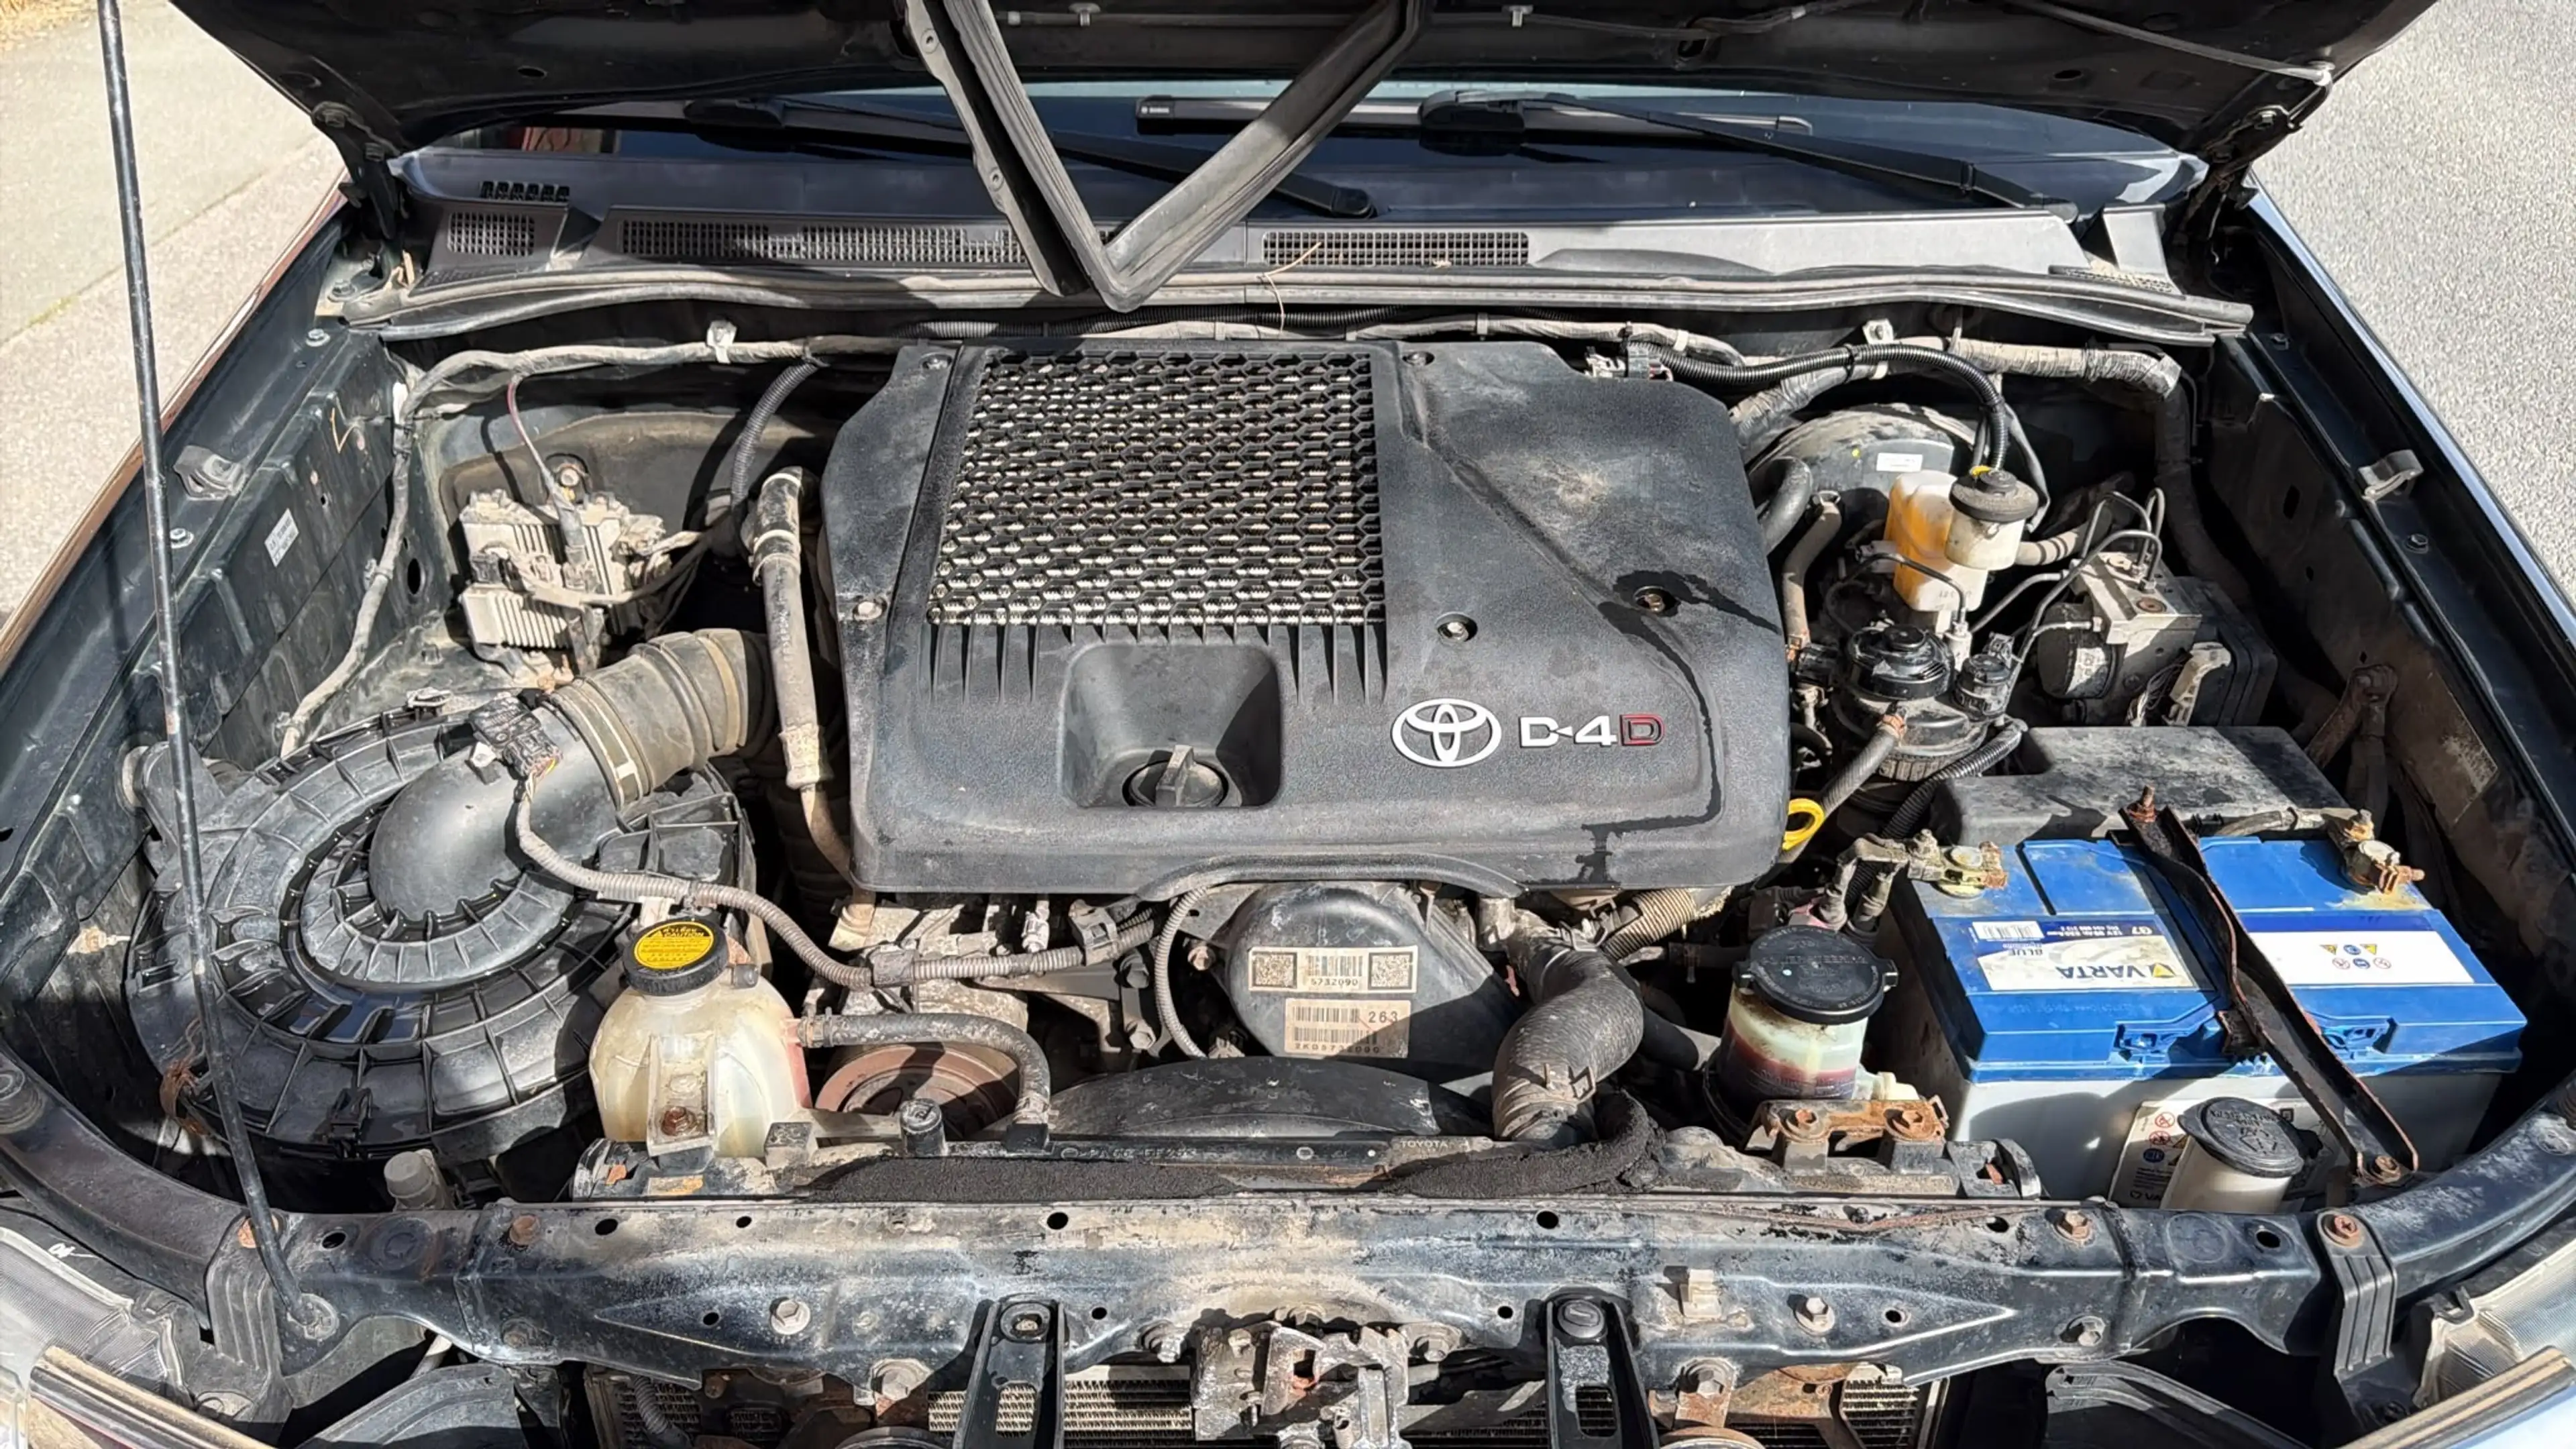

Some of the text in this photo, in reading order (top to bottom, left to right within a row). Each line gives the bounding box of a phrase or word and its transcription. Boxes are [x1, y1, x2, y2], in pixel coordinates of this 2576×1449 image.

[2055, 965, 2146, 979] VARTA
[1310, 978, 1358, 986] 5732090
[1368, 1011, 1398, 1024] 263
[1400, 1140, 1449, 1149] TOYOTA
